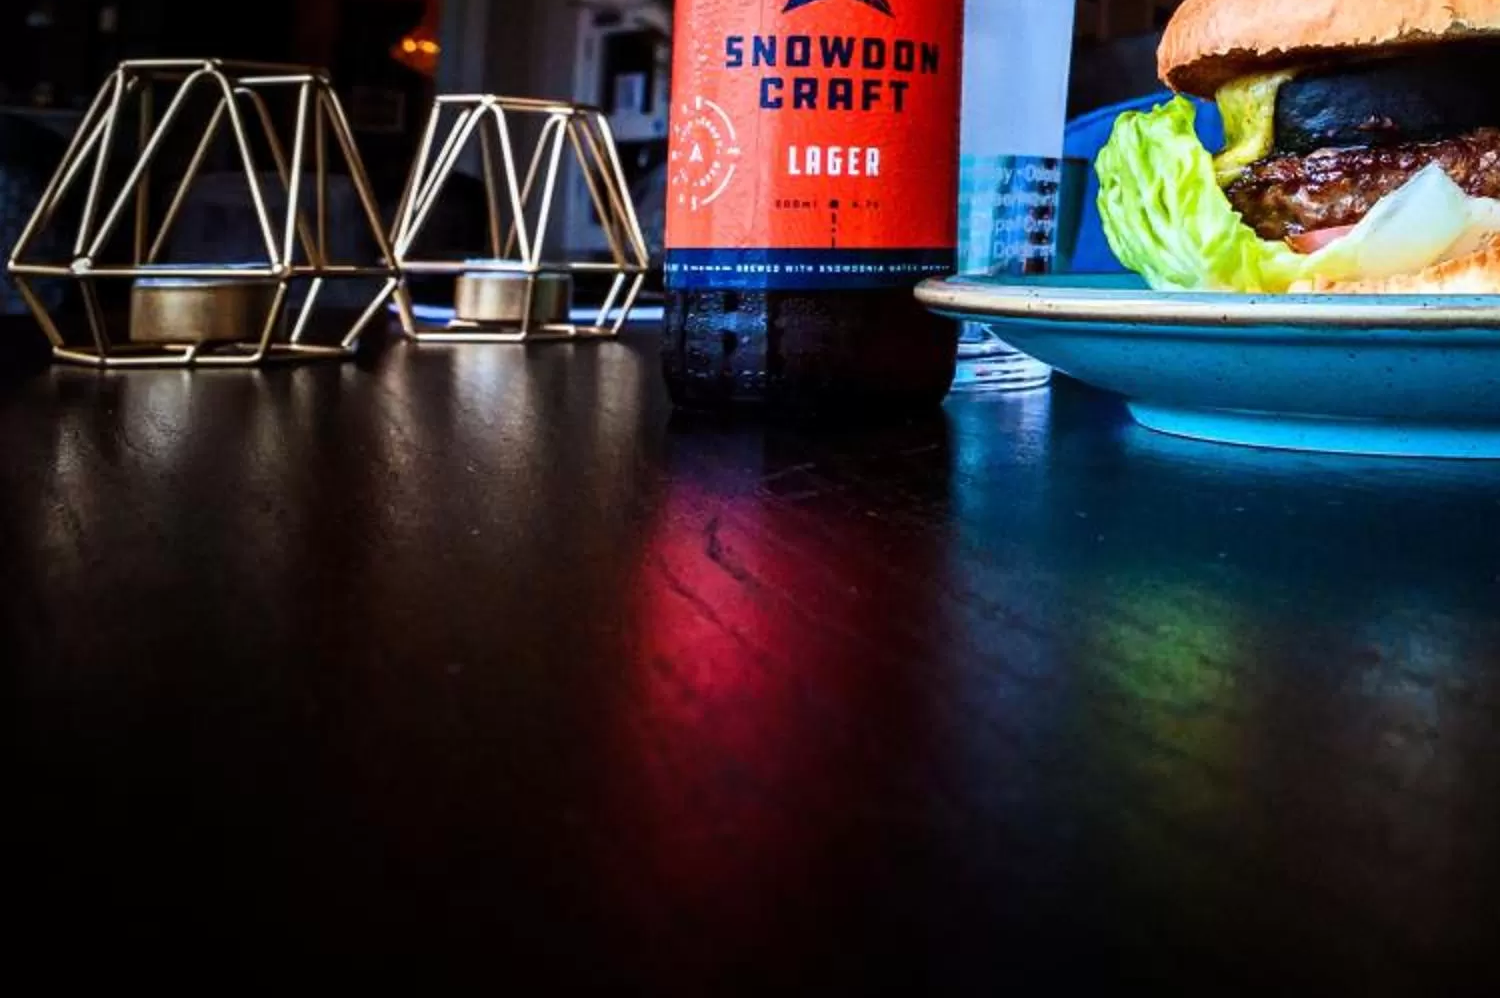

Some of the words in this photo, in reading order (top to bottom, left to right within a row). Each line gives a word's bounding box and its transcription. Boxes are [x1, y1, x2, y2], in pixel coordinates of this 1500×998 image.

[725, 35, 940, 74] SNOWDON
[759, 77, 910, 112] CRAFT
[788, 145, 881, 177] LAGER
[784, 264, 814, 273] WITH
